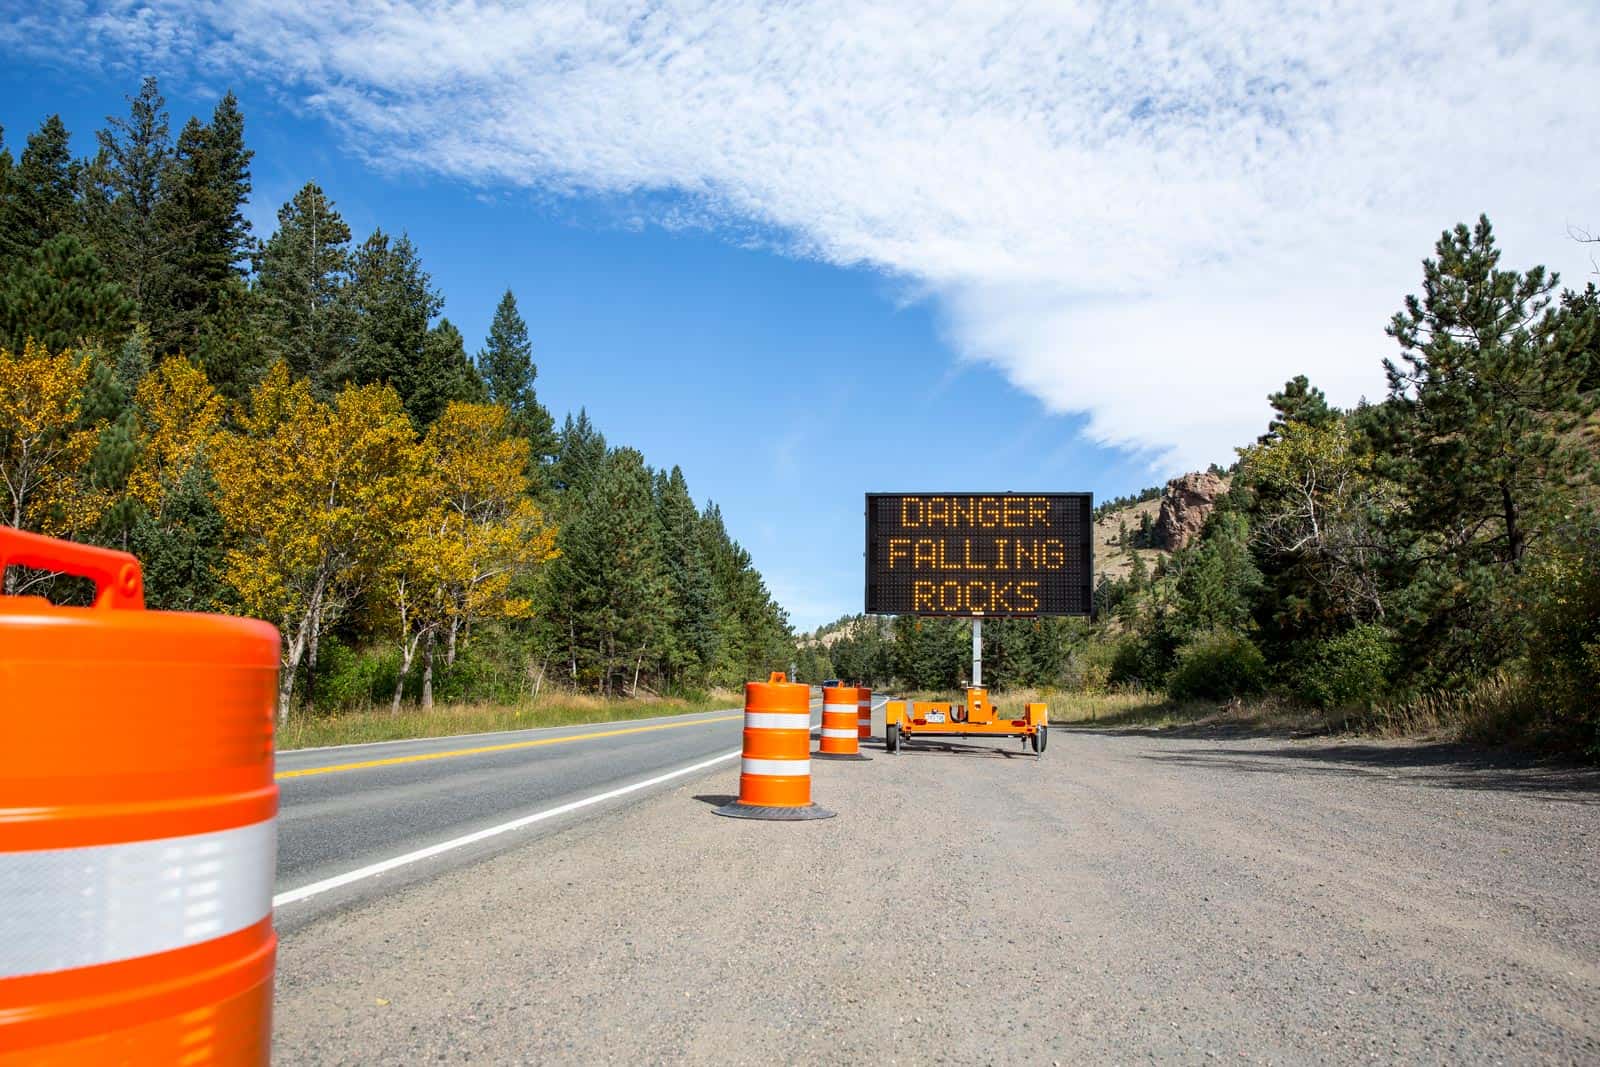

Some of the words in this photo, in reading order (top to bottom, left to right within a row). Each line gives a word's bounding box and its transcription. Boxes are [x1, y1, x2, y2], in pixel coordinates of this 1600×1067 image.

[902, 497, 1051, 527] DANGER
[889, 539, 1065, 569] FALLING
[914, 581, 1041, 611] ROCKS
